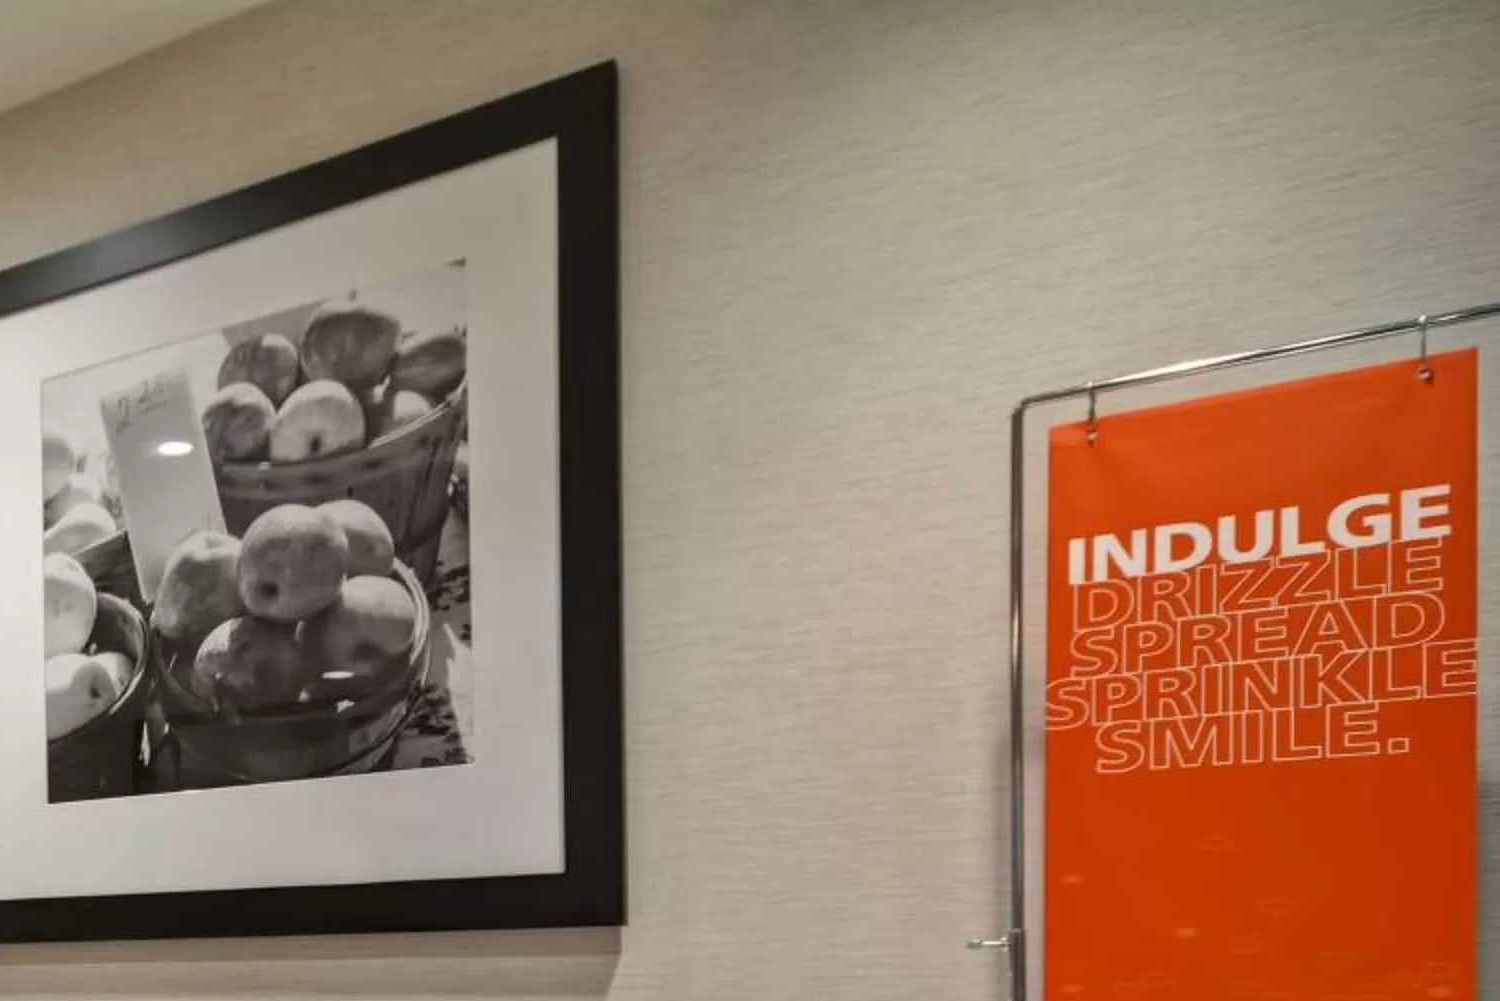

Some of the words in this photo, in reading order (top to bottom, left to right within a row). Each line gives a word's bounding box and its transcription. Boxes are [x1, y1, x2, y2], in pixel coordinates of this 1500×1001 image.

[1068, 484, 1452, 586] INDULGE
[1073, 534, 1445, 633] DRIZZLE
[1070, 592, 1446, 681] SPREAD
[1046, 638, 1477, 732] SPRINKLE
[1095, 701, 1410, 774] SMILE.
